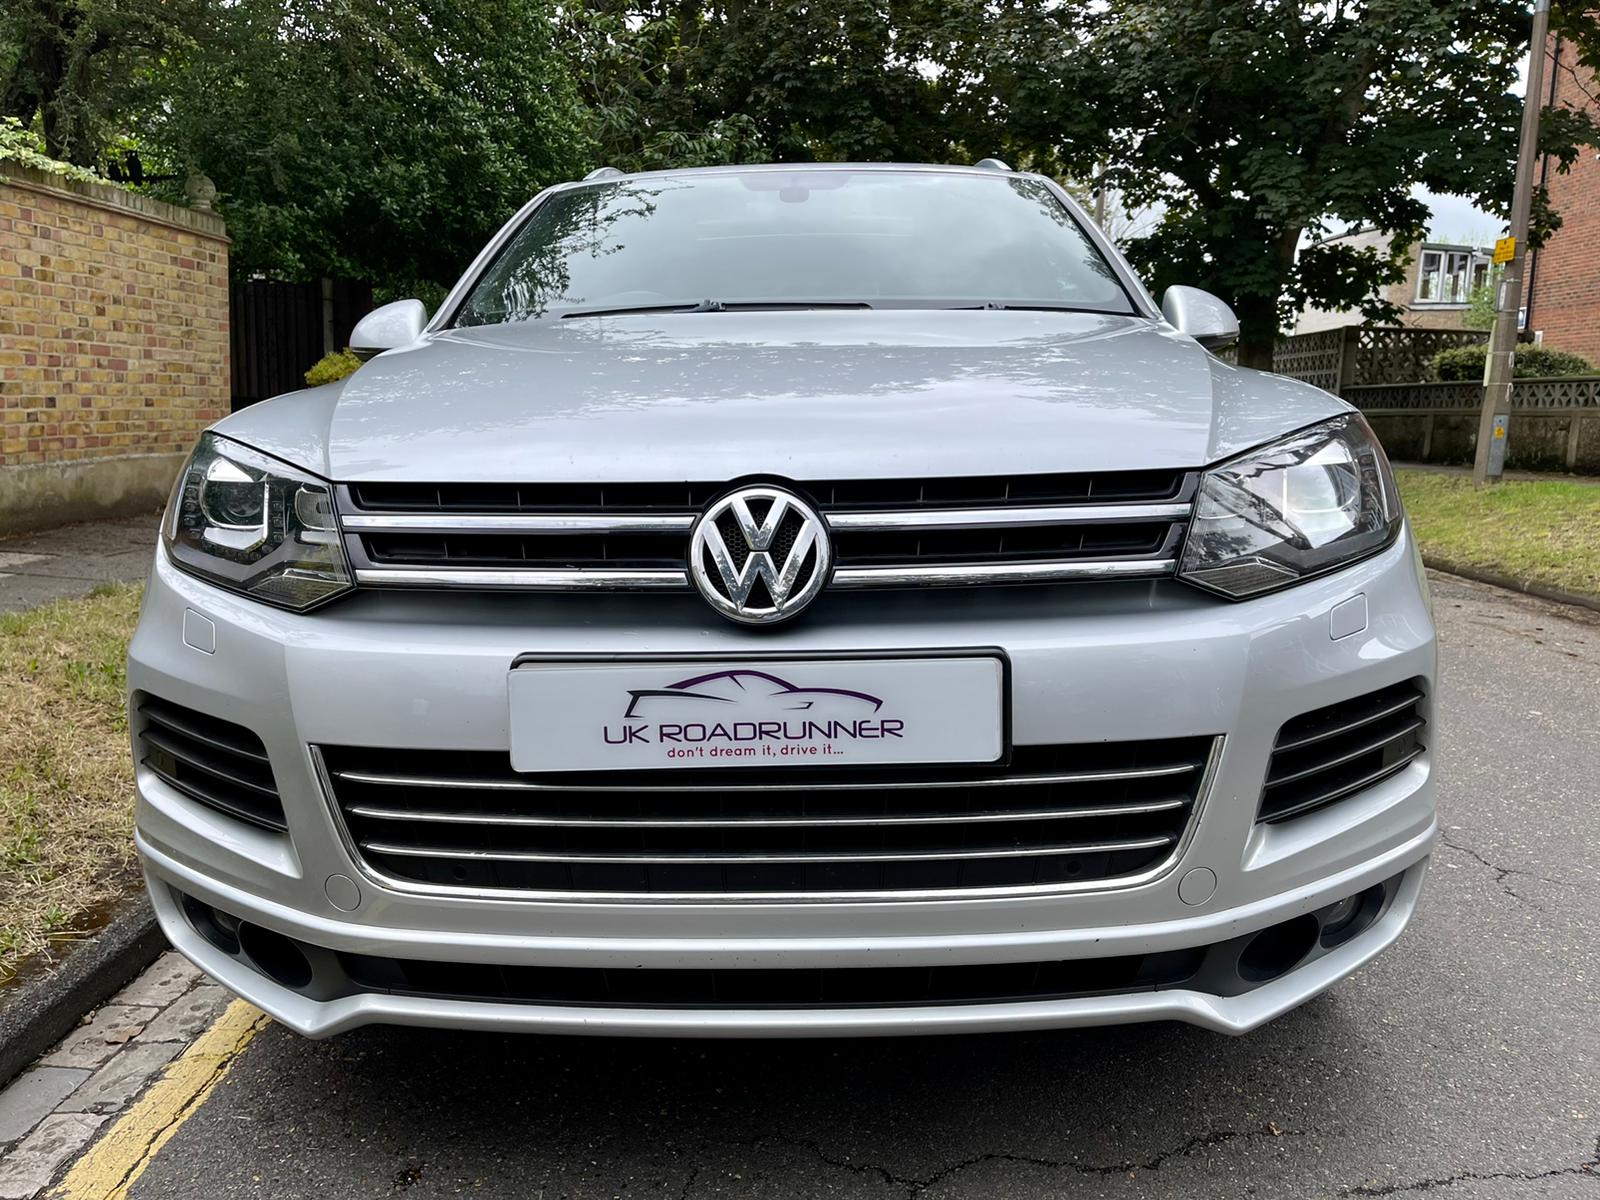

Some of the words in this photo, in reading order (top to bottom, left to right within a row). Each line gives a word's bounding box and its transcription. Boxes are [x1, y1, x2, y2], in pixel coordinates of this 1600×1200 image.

[700, 492, 820, 614] VW
[604, 725, 650, 745] UK
[659, 719, 905, 744] ROADRUNNER
[666, 746, 705, 759] don't
[709, 745, 757, 758] dream
[762, 744, 777, 758] it,
[779, 743, 818, 756] drive
[822, 743, 844, 756] it...
